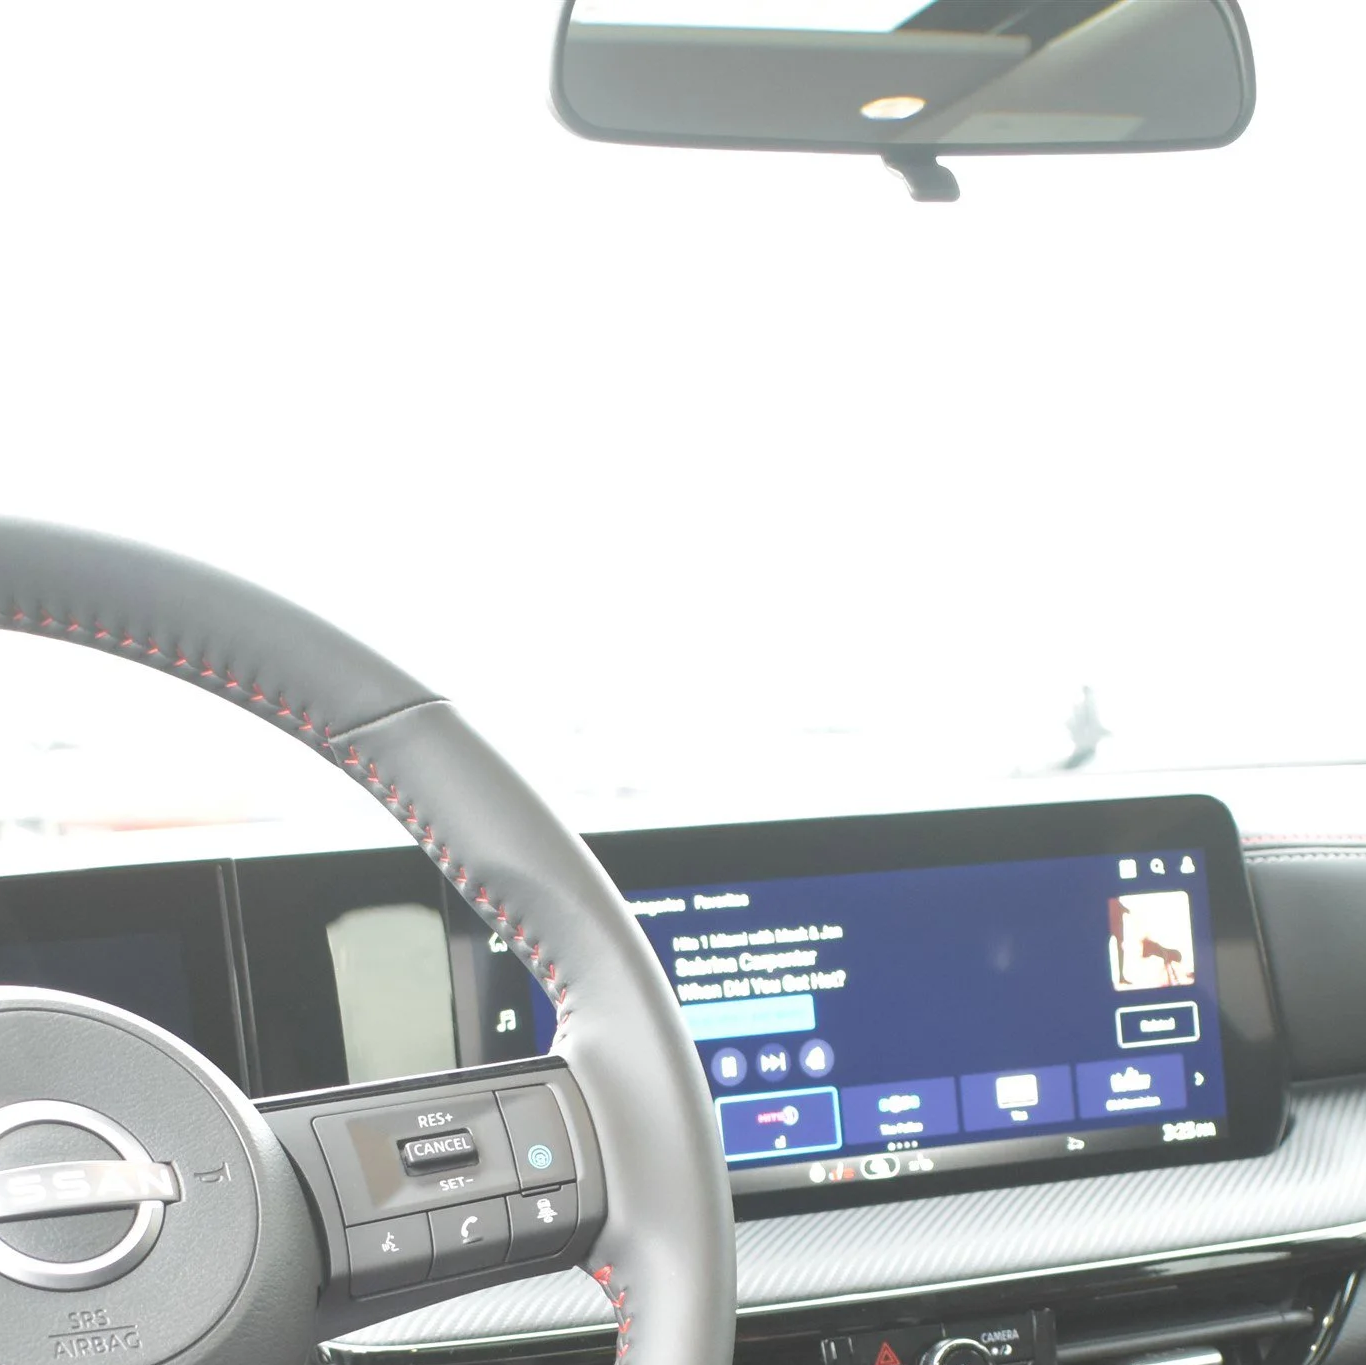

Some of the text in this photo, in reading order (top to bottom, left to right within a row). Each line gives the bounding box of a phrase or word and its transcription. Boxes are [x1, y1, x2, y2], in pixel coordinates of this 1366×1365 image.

[417, 1112, 453, 1128] RES+
[413, 1137, 471, 1156] CANCEL
[68, 1308, 111, 1329] SRS
[980, 1328, 1020, 1343] CAMERA
[53, 1331, 143, 1360] AIRBAG
